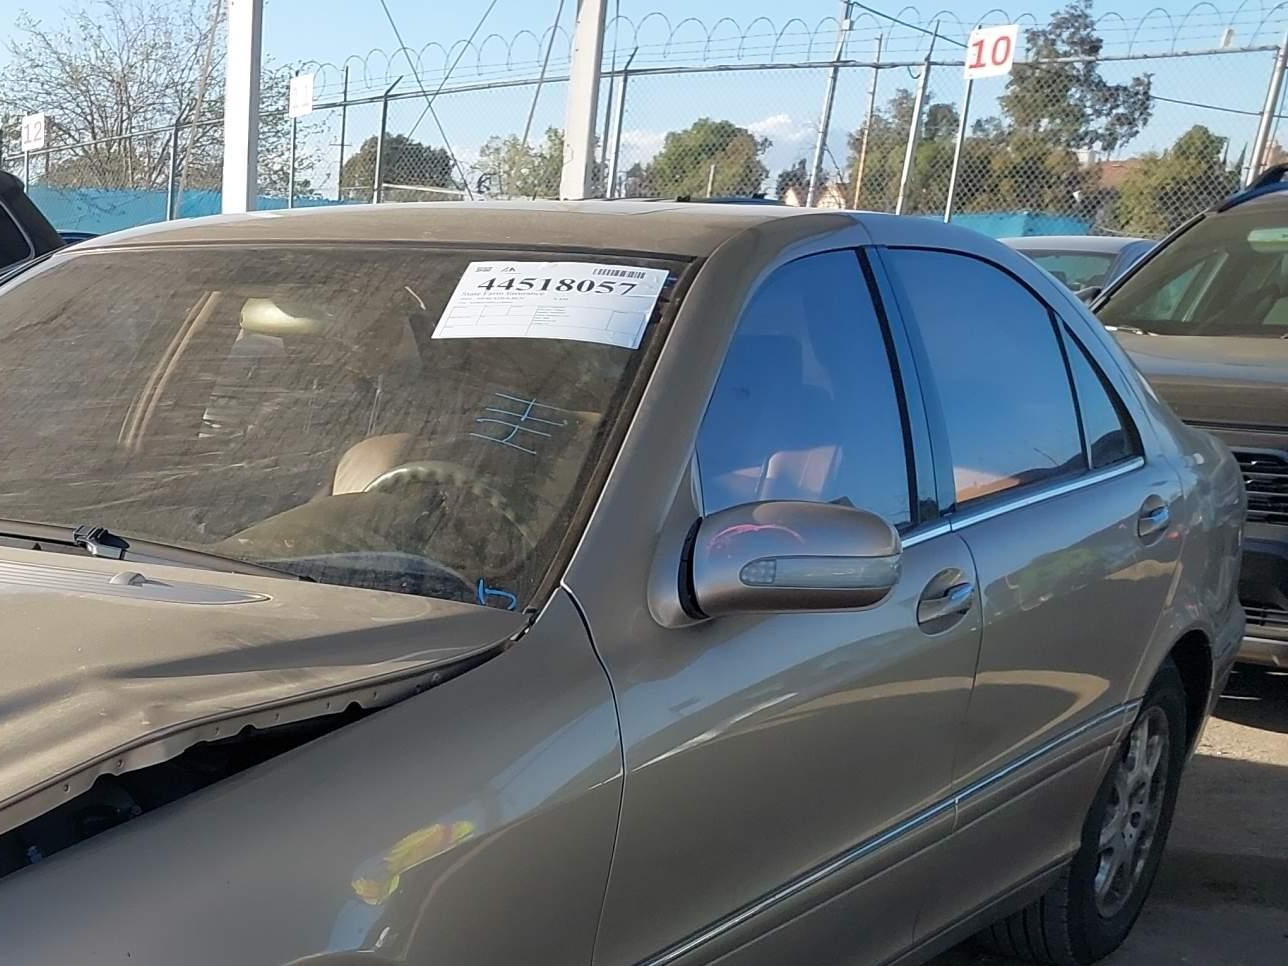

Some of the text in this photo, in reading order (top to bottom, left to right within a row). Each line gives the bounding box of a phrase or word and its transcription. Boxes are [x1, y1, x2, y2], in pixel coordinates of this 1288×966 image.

[968, 36, 1011, 69] 10
[23, 121, 42, 145] 12
[477, 277, 638, 295] 44518057
